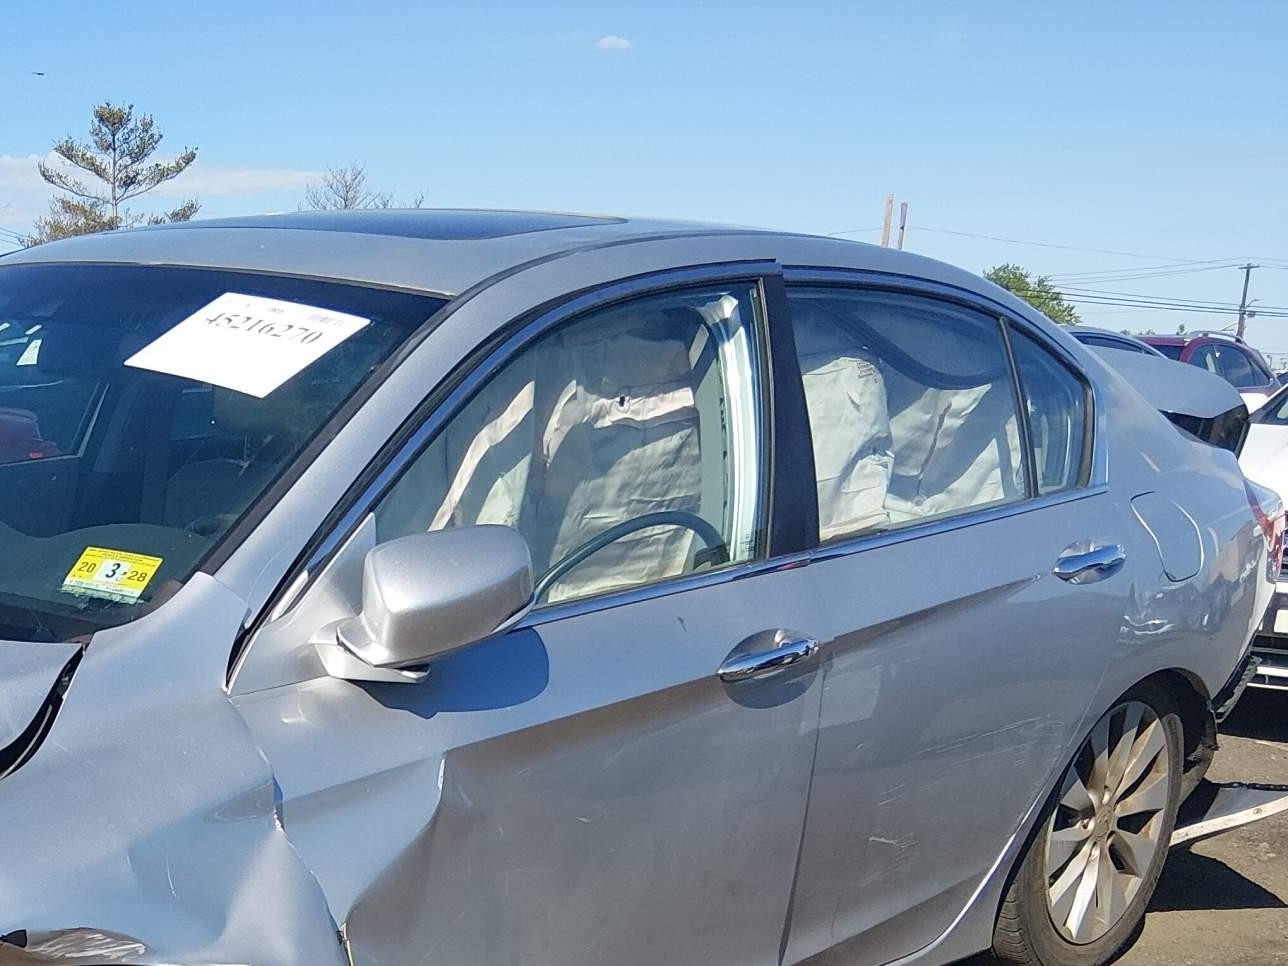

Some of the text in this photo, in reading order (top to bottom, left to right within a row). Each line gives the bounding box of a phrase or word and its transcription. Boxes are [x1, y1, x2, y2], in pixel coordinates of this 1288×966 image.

[204, 312, 324, 345] 45216270
[78, 561, 148, 582] 20 3 28
